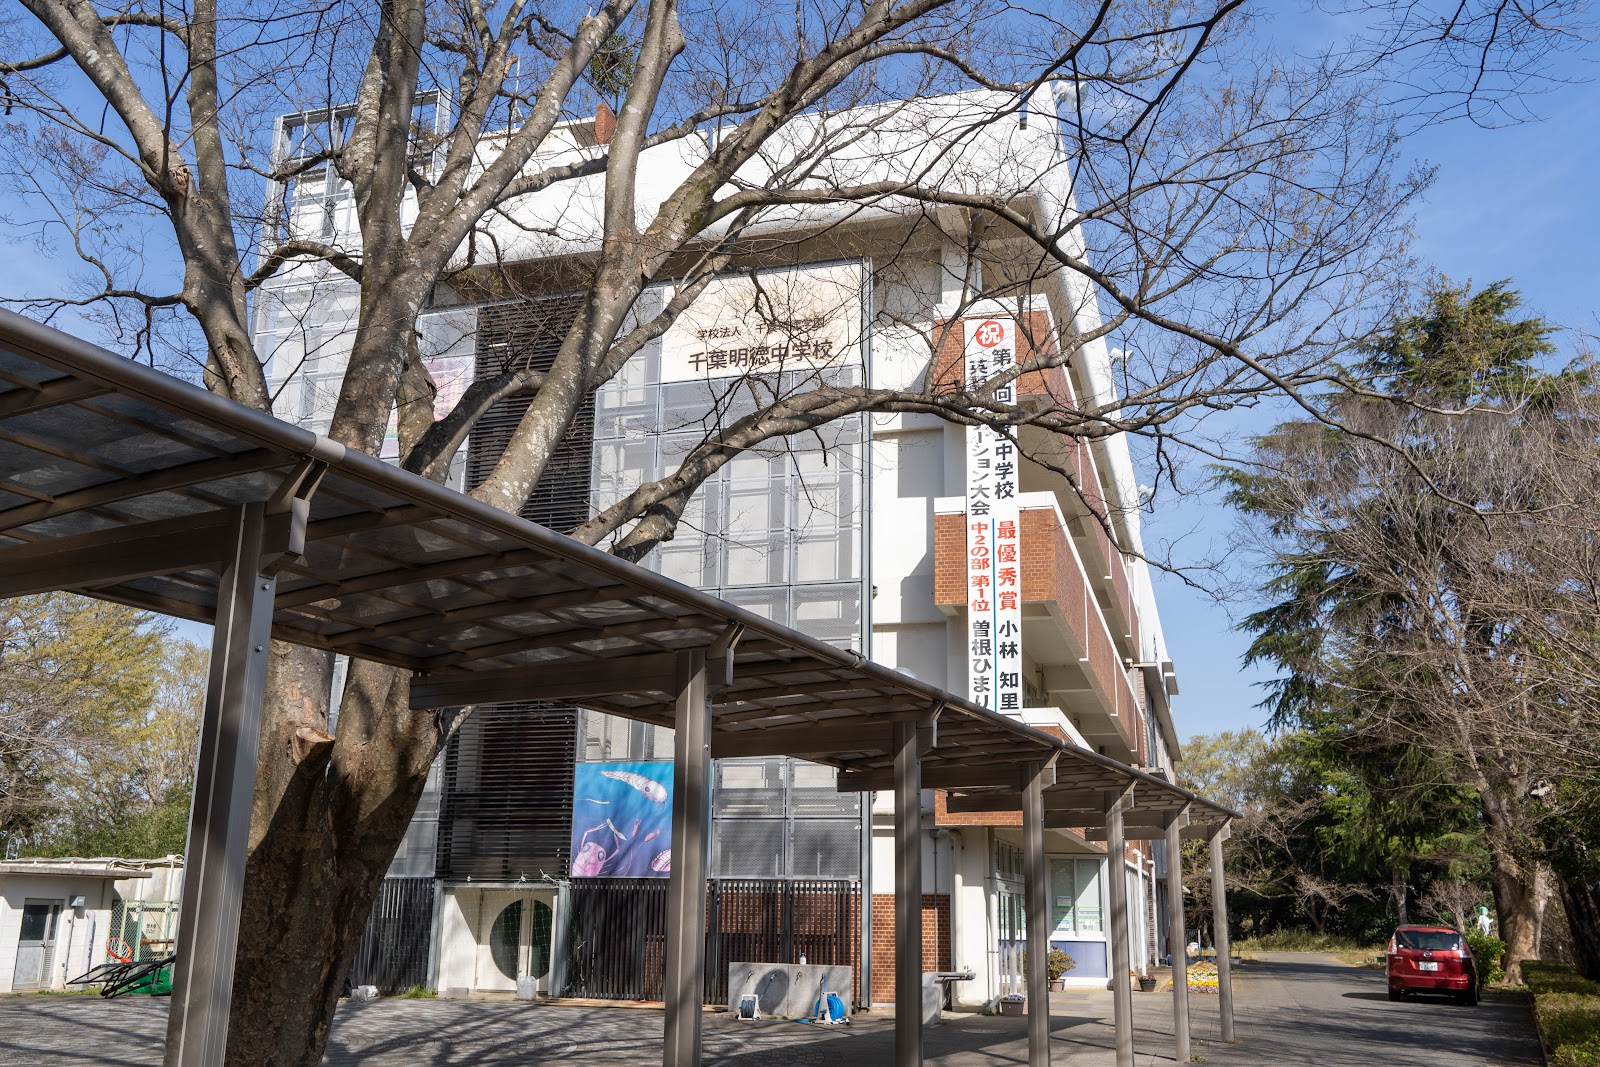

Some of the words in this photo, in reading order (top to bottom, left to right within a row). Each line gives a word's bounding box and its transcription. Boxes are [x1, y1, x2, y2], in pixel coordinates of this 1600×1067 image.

[696, 326, 742, 341] 学校法人
[978, 323, 1002, 345] 祝
[688, 339, 833, 372] 千葉明徳中学校
[970, 521, 990, 571] 中2の部
[997, 520, 1017, 611] 最優秀賞
[971, 574, 991, 612] 第1位
[999, 620, 1019, 659] 小林
[999, 671, 1019, 710] 知里
